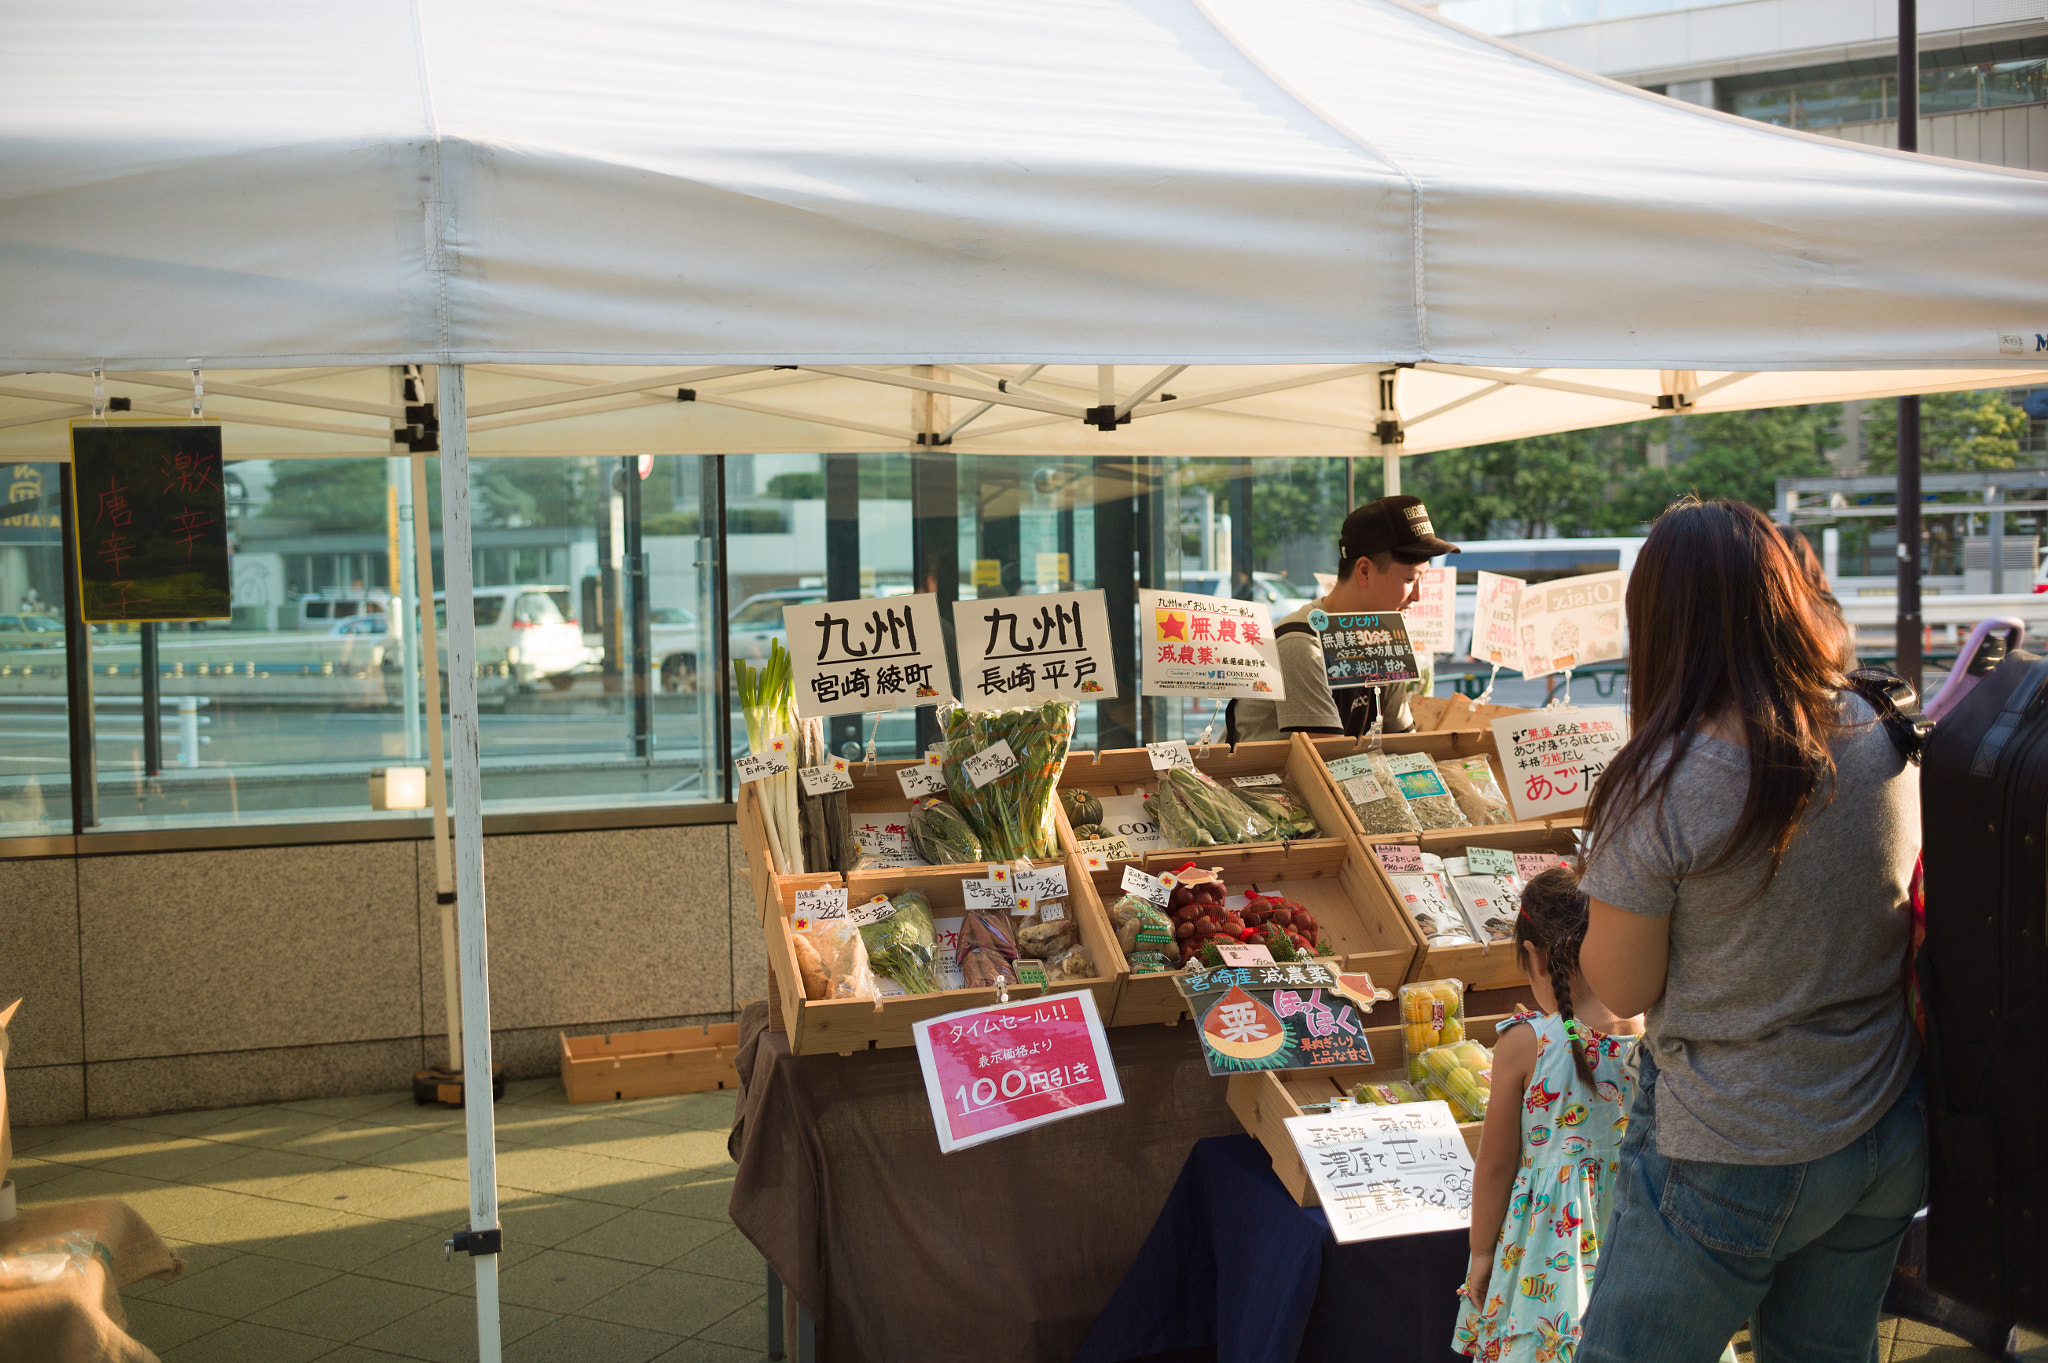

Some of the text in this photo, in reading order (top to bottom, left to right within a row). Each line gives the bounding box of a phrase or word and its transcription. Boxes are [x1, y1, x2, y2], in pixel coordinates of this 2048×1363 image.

[815, 604, 917, 660] 九州
[984, 601, 1083, 655] 九州
[1191, 613, 1264, 646] 無農薬
[1338, 615, 1379, 628] ヒノヒカリ
[811, 664, 933, 703] 宮崎綾町
[977, 656, 1097, 696] 長崎平戸
[1226, 670, 1260, 678] CONFARM
[810, 773, 838, 786] ごぼう
[908, 775, 933, 788] ゴーヤ
[970, 887, 1010, 898] さつまいも
[1185, 965, 1334, 992] 宮崎産 減農薬
[950, 1004, 1069, 1044] タイムセール!!
[1219, 1001, 1269, 1043] 栗
[978, 1038, 1053, 1069] 表示価格より
[1300, 1035, 1354, 1052] 果肉ぎっしり
[1310, 1048, 1370, 1065] 上品な甘さ
[955, 1062, 1090, 1114] 100円引き
